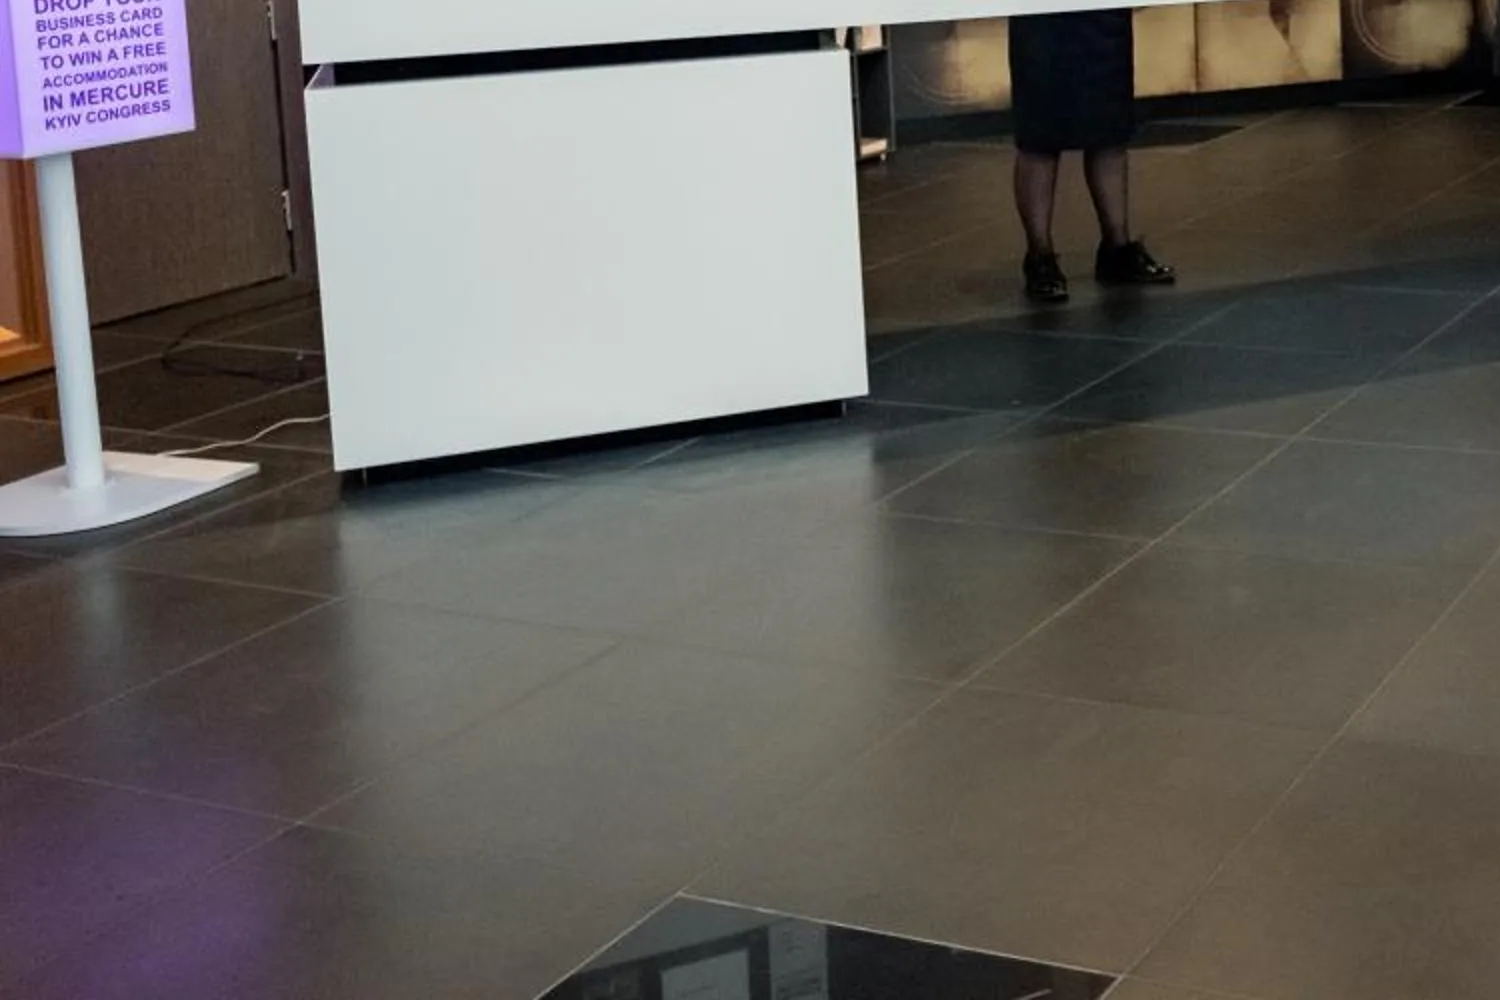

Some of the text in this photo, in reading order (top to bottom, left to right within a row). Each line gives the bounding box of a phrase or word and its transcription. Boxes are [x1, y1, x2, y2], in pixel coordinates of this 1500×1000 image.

[35, 7, 163, 33] BUSINESS CARD
[37, 22, 164, 51] FOR A CHANCE
[40, 41, 167, 71] TO WIN A FREE
[42, 61, 168, 89] ACCOMMODATION
[43, 79, 169, 112] IN MERCURE
[45, 99, 171, 131] KYIV CONGRESS
